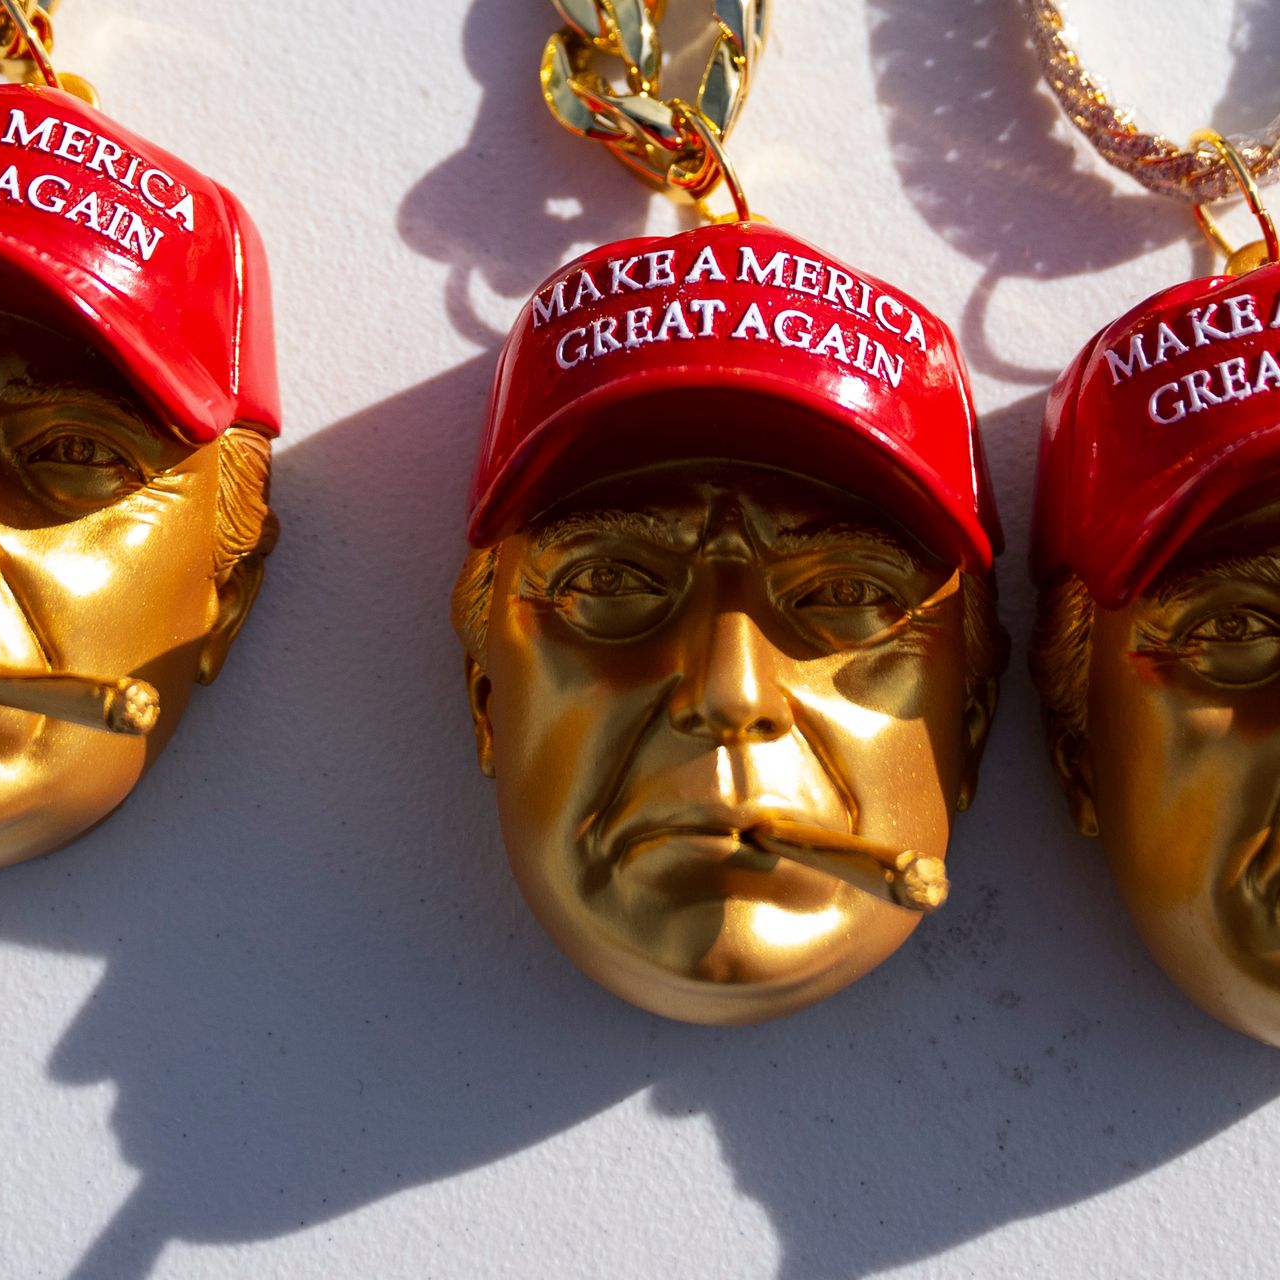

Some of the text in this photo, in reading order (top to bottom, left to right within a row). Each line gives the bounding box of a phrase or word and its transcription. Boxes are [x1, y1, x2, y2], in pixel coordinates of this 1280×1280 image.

[532, 250, 676, 329] MAKE
[555, 299, 905, 389] GREAT AGAIN
[1102, 294, 1263, 385] MAKE
